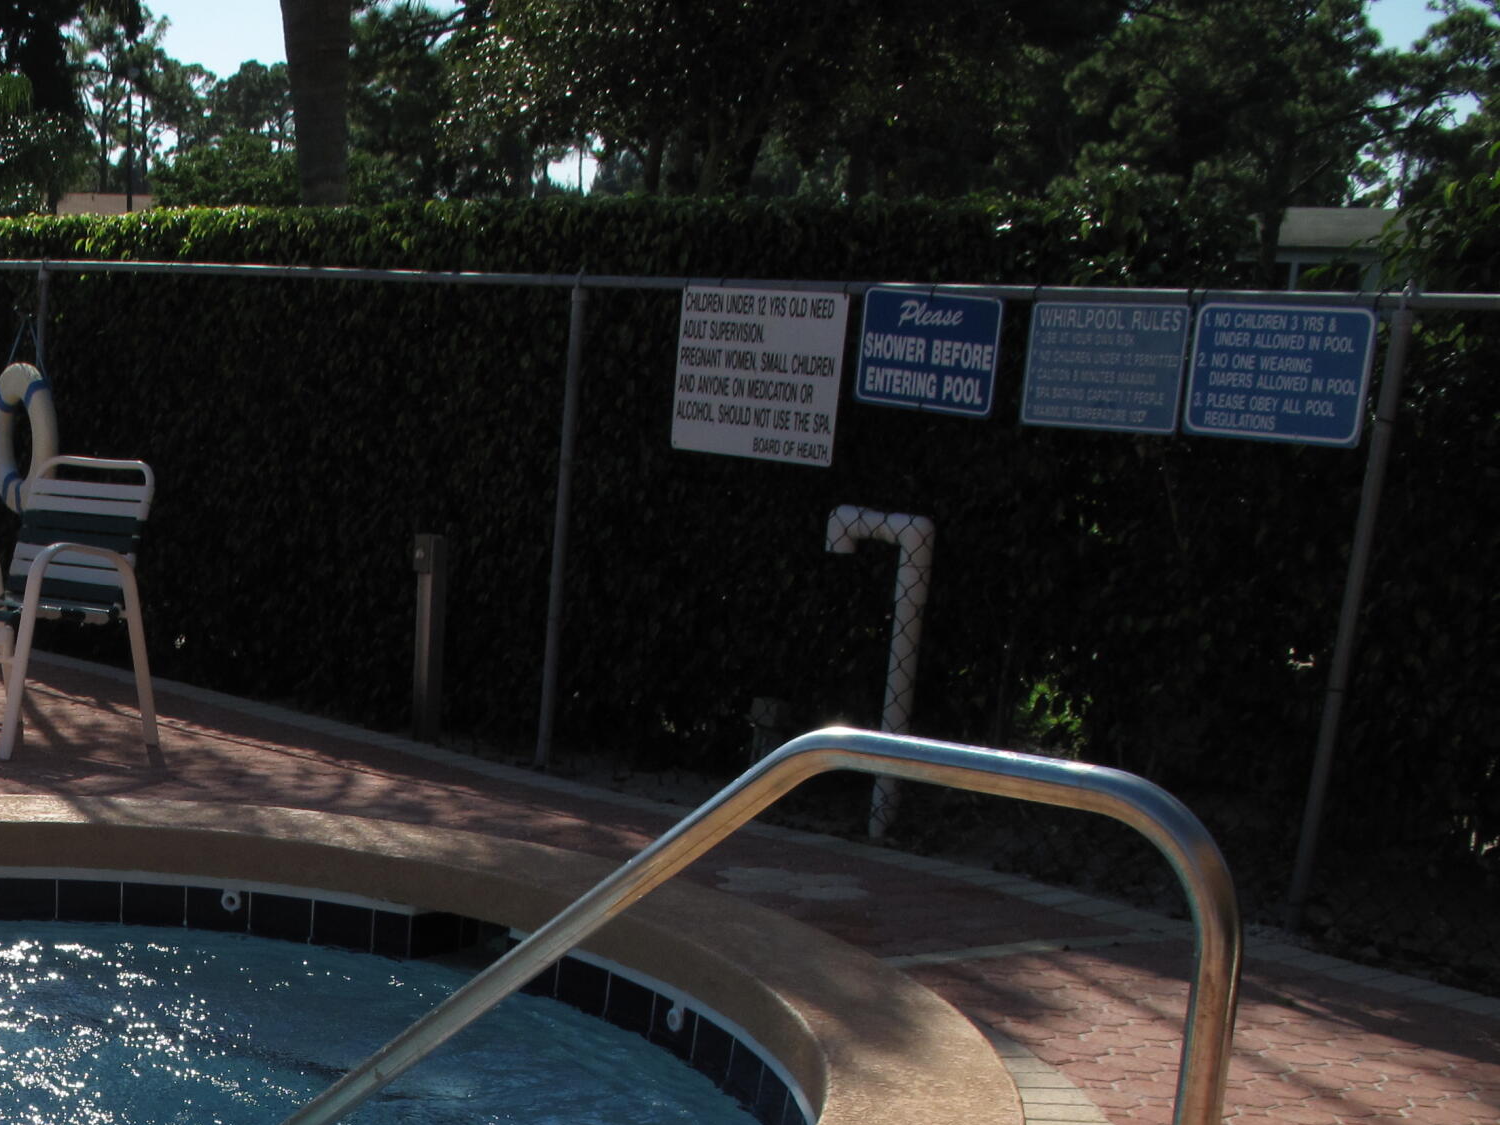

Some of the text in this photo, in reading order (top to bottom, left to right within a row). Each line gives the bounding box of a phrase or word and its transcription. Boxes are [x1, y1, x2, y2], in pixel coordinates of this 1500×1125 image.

[686, 292, 835, 320] CHILDREN UNDER 12 YRS OLD NEED
[898, 300, 964, 327] Please
[683, 320, 764, 344] ADULT SUPERVISION.
[1040, 308, 1182, 332] WHIRLPOOL RULES
[1214, 312, 1231, 327] NO
[1234, 313, 1288, 330] CHILDREN
[1291, 315, 1298, 331] 3
[1302, 316, 1324, 333] YRS
[1328, 317, 1337, 332] &
[864, 332, 993, 371] SHOWER BEFORE
[1214, 331, 1354, 353] UNDER ALLOWED IN POOL
[680, 346, 722, 368] PREGNANT
[761, 352, 789, 374] SMALL
[791, 354, 835, 377] CHILDREN
[1052, 350, 1092, 364] CHILDREN
[1134, 353, 1180, 368] PERMITTED
[1211, 353, 1228, 368] NO
[1231, 354, 1256, 370] ONE
[1260, 356, 1313, 373] WEARING
[864, 366, 982, 405] ENTERING POOL
[1036, 367, 1072, 381] CAUTION
[1209, 371, 1357, 395] DIAPERS ALLOWED IN POOL
[678, 374, 814, 404] AND ANYONE ON MEDICATION OR
[1206, 393, 1245, 410] PLEASE
[1250, 395, 1278, 412] OBEY
[1281, 398, 1301, 414] ALL
[1305, 400, 1335, 416] POOL
[718, 404, 750, 426] SHOULD
[753, 407, 771, 428] NOT
[773, 409, 789, 430] USE
[794, 412, 809, 432] THE
[813, 414, 831, 434] SPA.
[1203, 411, 1276, 431] REGULATIONS
[753, 437, 780, 454] BOARD
[783, 440, 795, 457] OF
